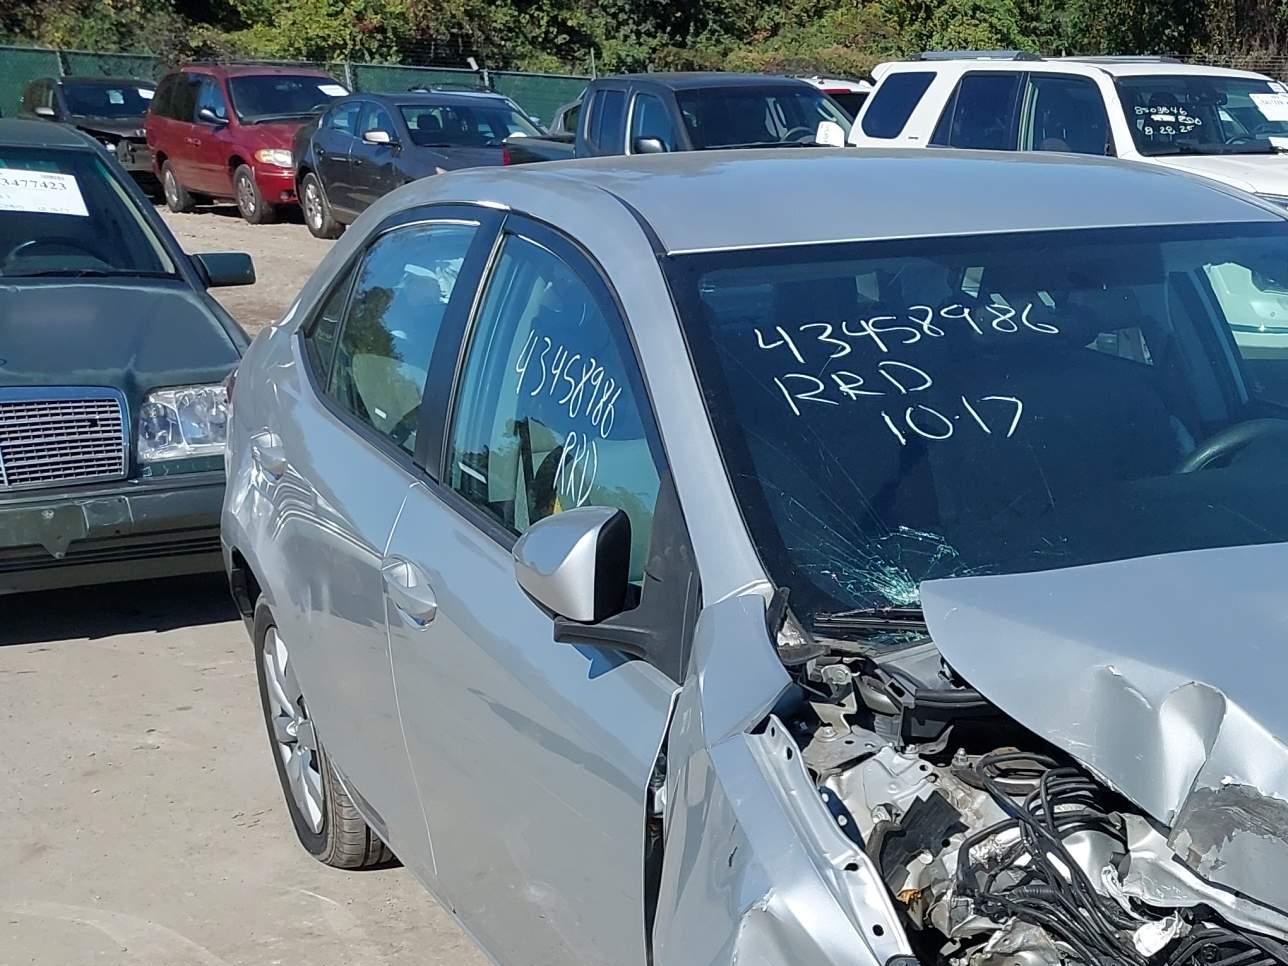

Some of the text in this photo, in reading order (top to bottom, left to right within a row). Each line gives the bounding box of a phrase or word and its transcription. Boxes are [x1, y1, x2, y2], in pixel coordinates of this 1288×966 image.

[753, 303, 1060, 364] 43458986
[515, 328, 623, 439] 43458986
[774, 360, 933, 416] RRD
